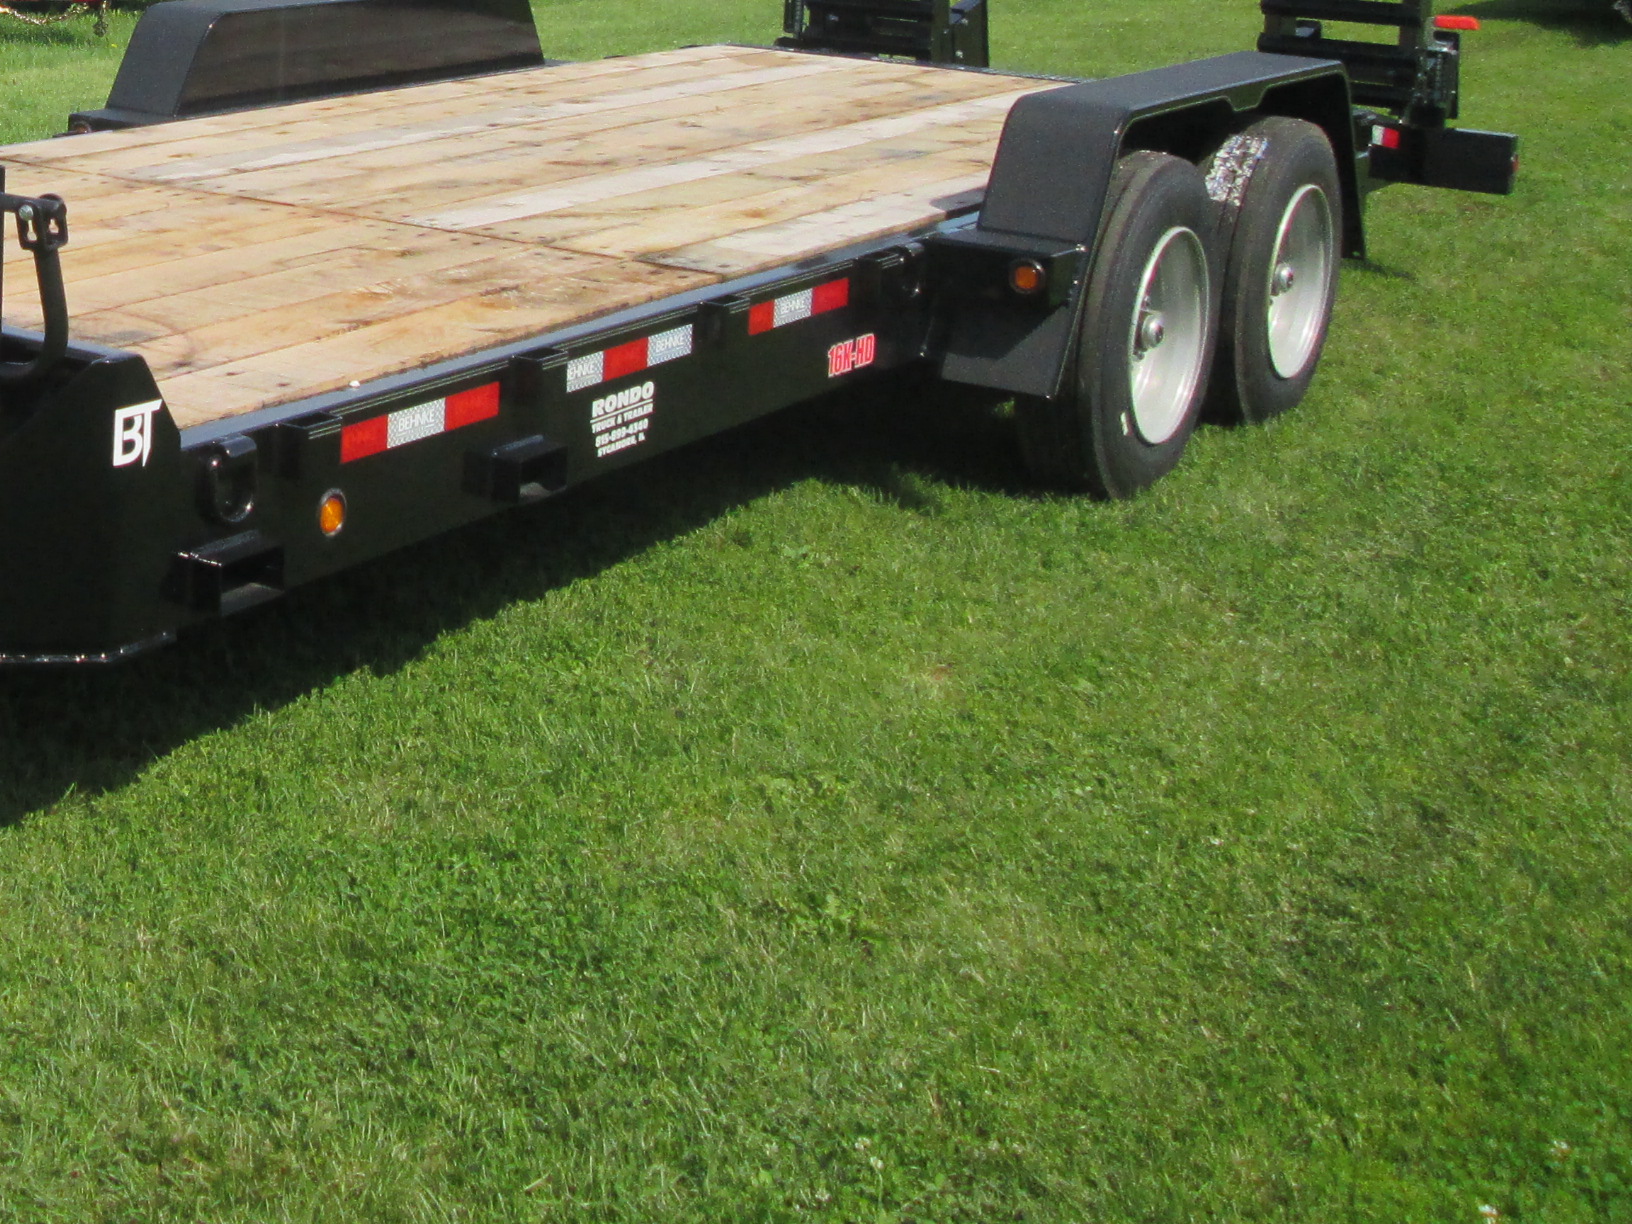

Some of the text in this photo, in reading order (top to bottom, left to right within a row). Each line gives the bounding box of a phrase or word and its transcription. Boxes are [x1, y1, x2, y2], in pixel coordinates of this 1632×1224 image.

[655, 336, 684, 353] BEHNKE
[828, 333, 876, 378] 16K-HD
[592, 381, 655, 418] RONDO
[113, 398, 163, 467] BT
[398, 407, 436, 432] BEHNKE
[592, 416, 617, 434] TRUCK
[623, 402, 654, 422] TRAILER
